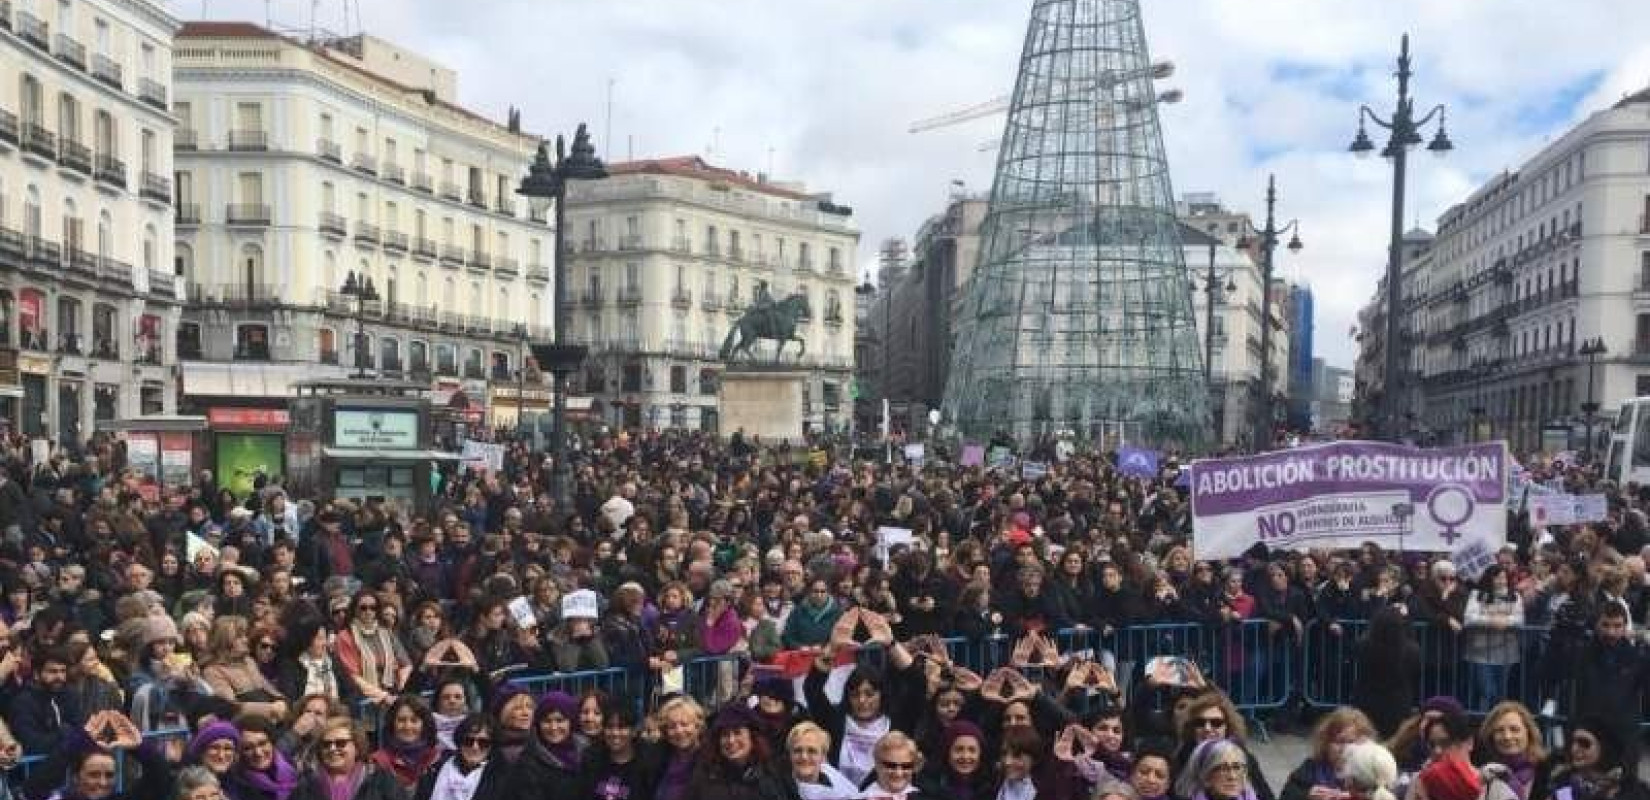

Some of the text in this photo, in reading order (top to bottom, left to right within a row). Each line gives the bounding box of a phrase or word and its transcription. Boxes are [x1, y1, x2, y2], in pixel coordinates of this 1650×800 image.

[1198, 451, 1498, 495] ABOLICIÓN PROSTITUCIÓN
[1257, 511, 1296, 539] NO
